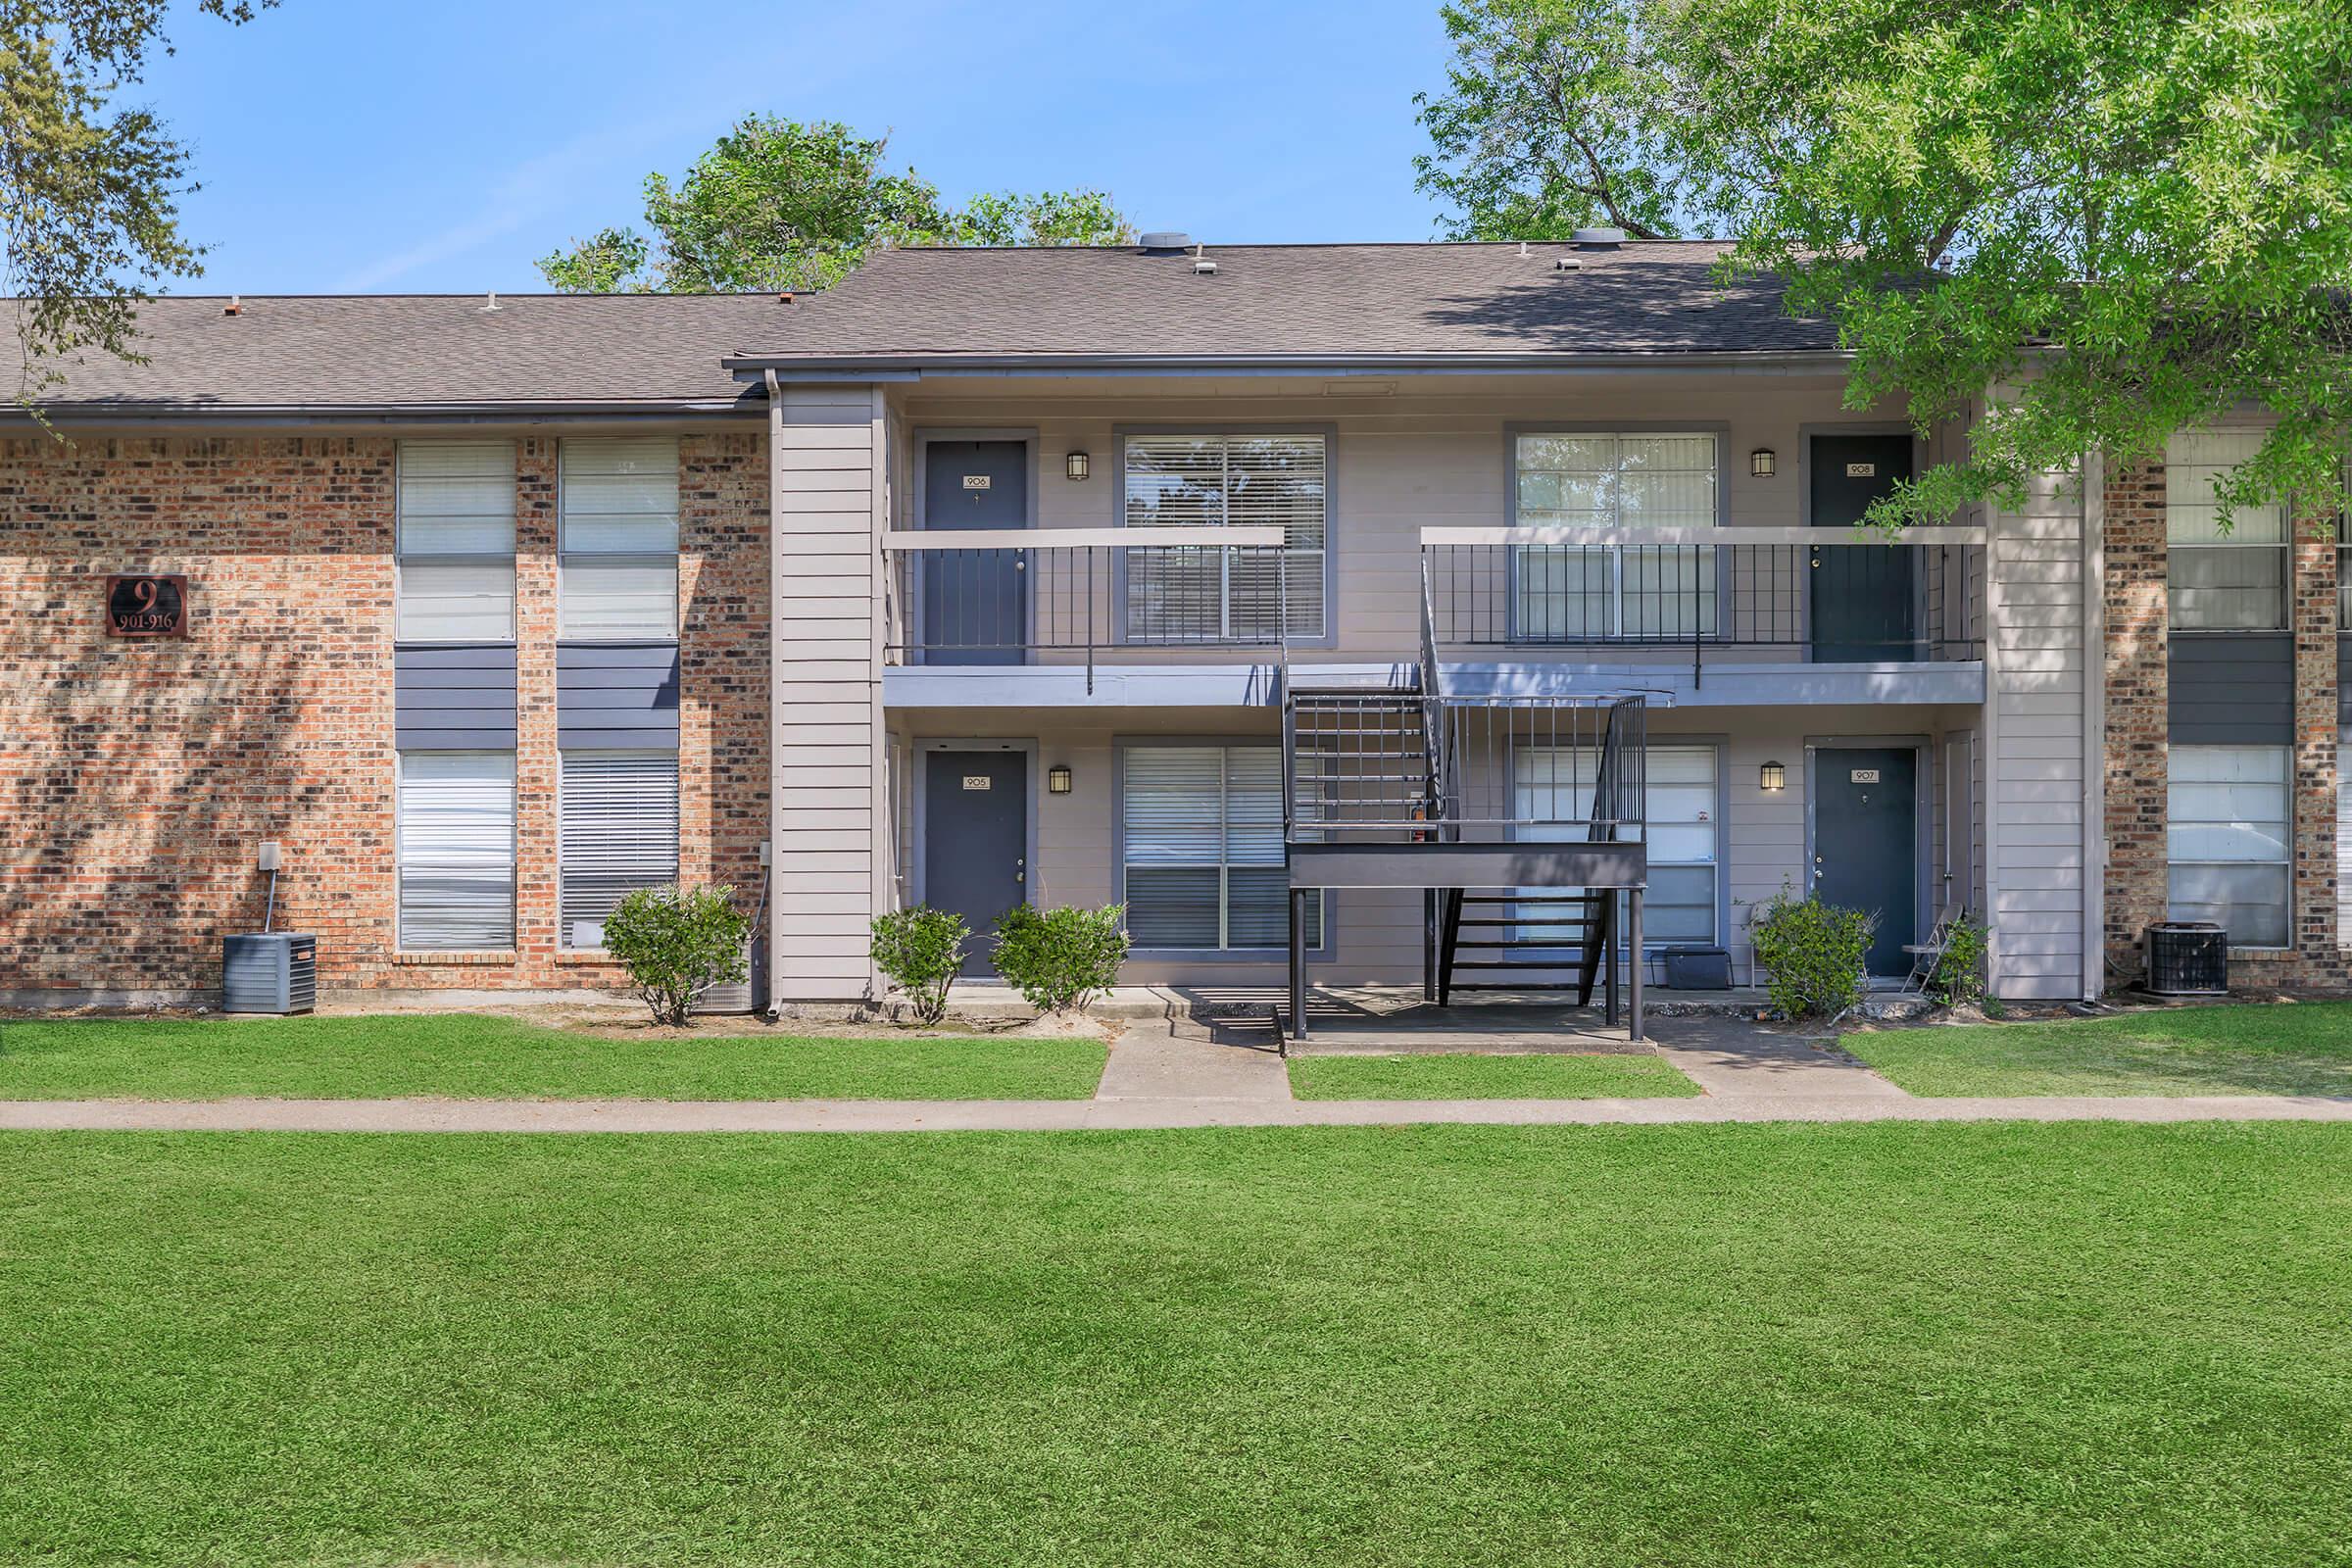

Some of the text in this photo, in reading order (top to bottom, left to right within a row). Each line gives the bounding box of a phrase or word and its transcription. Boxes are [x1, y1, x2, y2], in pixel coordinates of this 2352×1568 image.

[1851, 465, 1870, 473] 908
[967, 477, 986, 486] 906
[134, 580, 157, 614] 9
[120, 612, 172, 629] 901-916
[1856, 771, 1875, 780] 907
